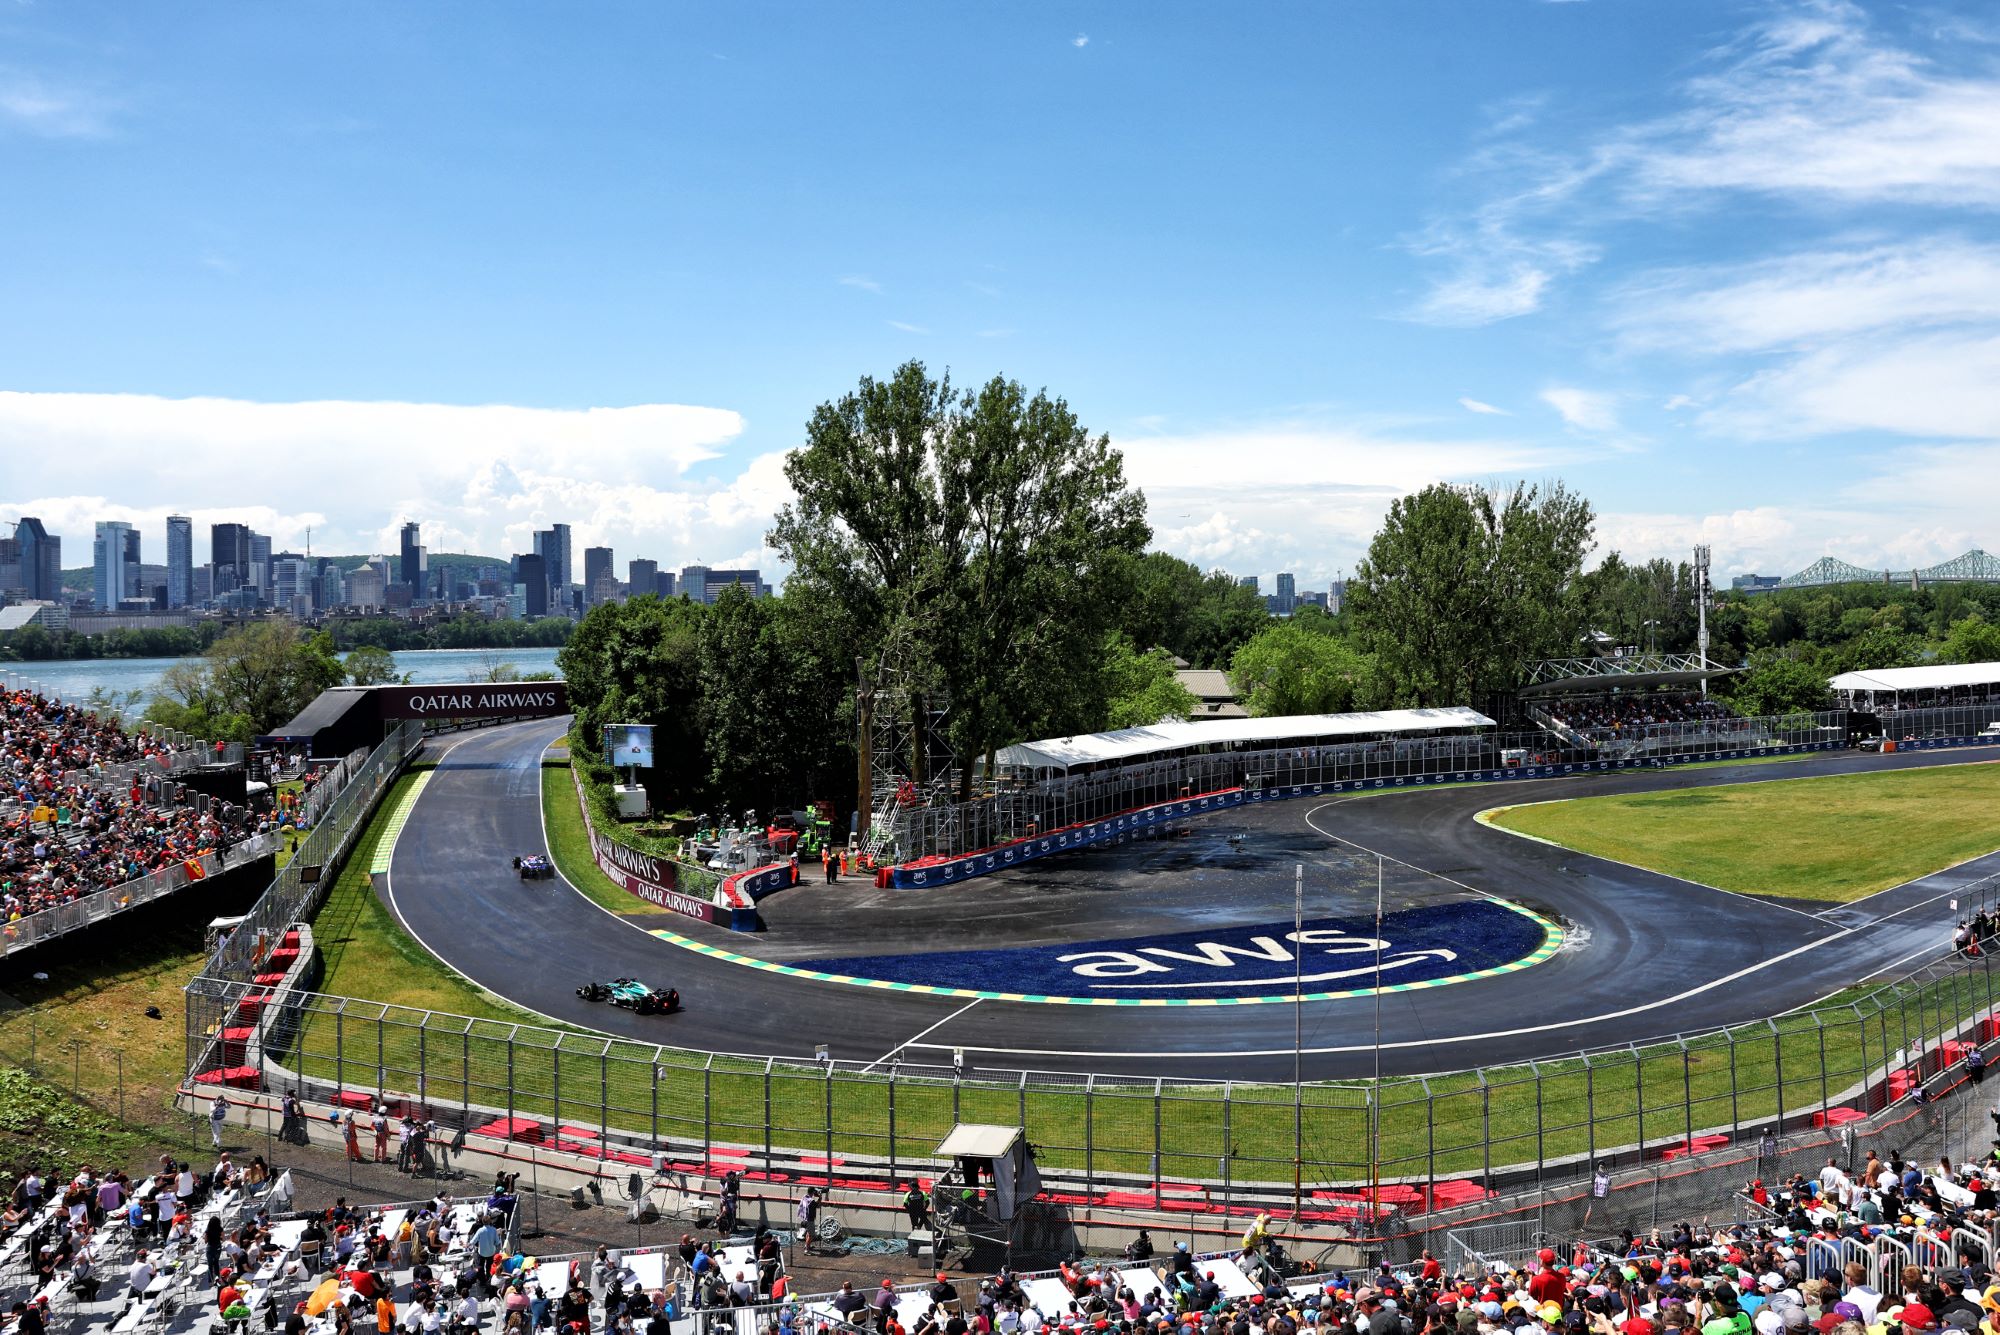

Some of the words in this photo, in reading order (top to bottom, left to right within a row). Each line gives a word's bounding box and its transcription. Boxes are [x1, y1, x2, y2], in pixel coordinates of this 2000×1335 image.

[409, 695, 473, 713] QATAR
[478, 692, 556, 708] AIRWAYS
[614, 844, 660, 882] AIRWAYS
[637, 883, 663, 905] QATAR
[665, 892, 703, 918] AIRWAYS
[1056, 929, 1392, 977] aws
